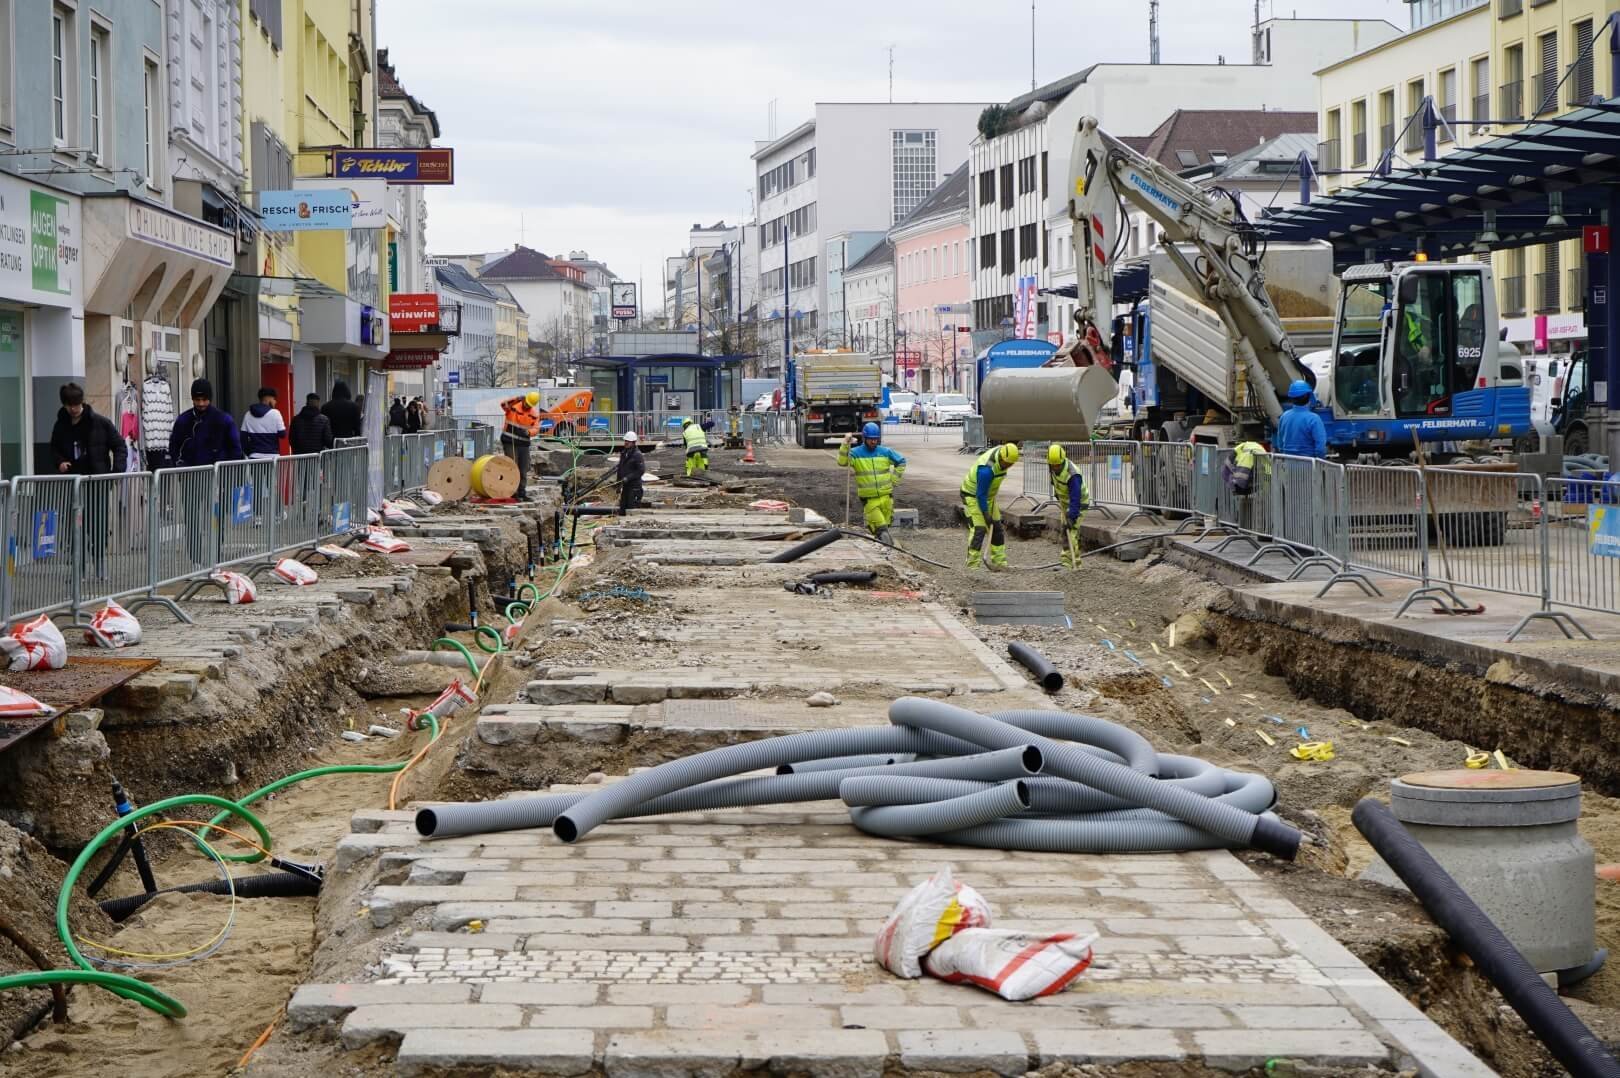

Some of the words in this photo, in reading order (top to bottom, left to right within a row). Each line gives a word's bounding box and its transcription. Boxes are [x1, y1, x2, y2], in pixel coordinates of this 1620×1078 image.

[358, 159, 411, 172] Tchibo
[1130, 173, 1178, 211] FELBERMAYR
[262, 206, 296, 215] RESCH
[298, 202, 310, 218] &
[312, 205, 349, 214] FRISCH
[32, 209, 56, 239] AUGEN
[136, 208, 176, 242] DHILLON
[181, 222, 204, 253] MODE
[208, 233, 228, 258] SHOP
[58, 240, 79, 265] aigner
[1592, 231, 1600, 249] 1
[32, 243, 57, 272] OPTIK
[1457, 347, 1481, 358] 6925
